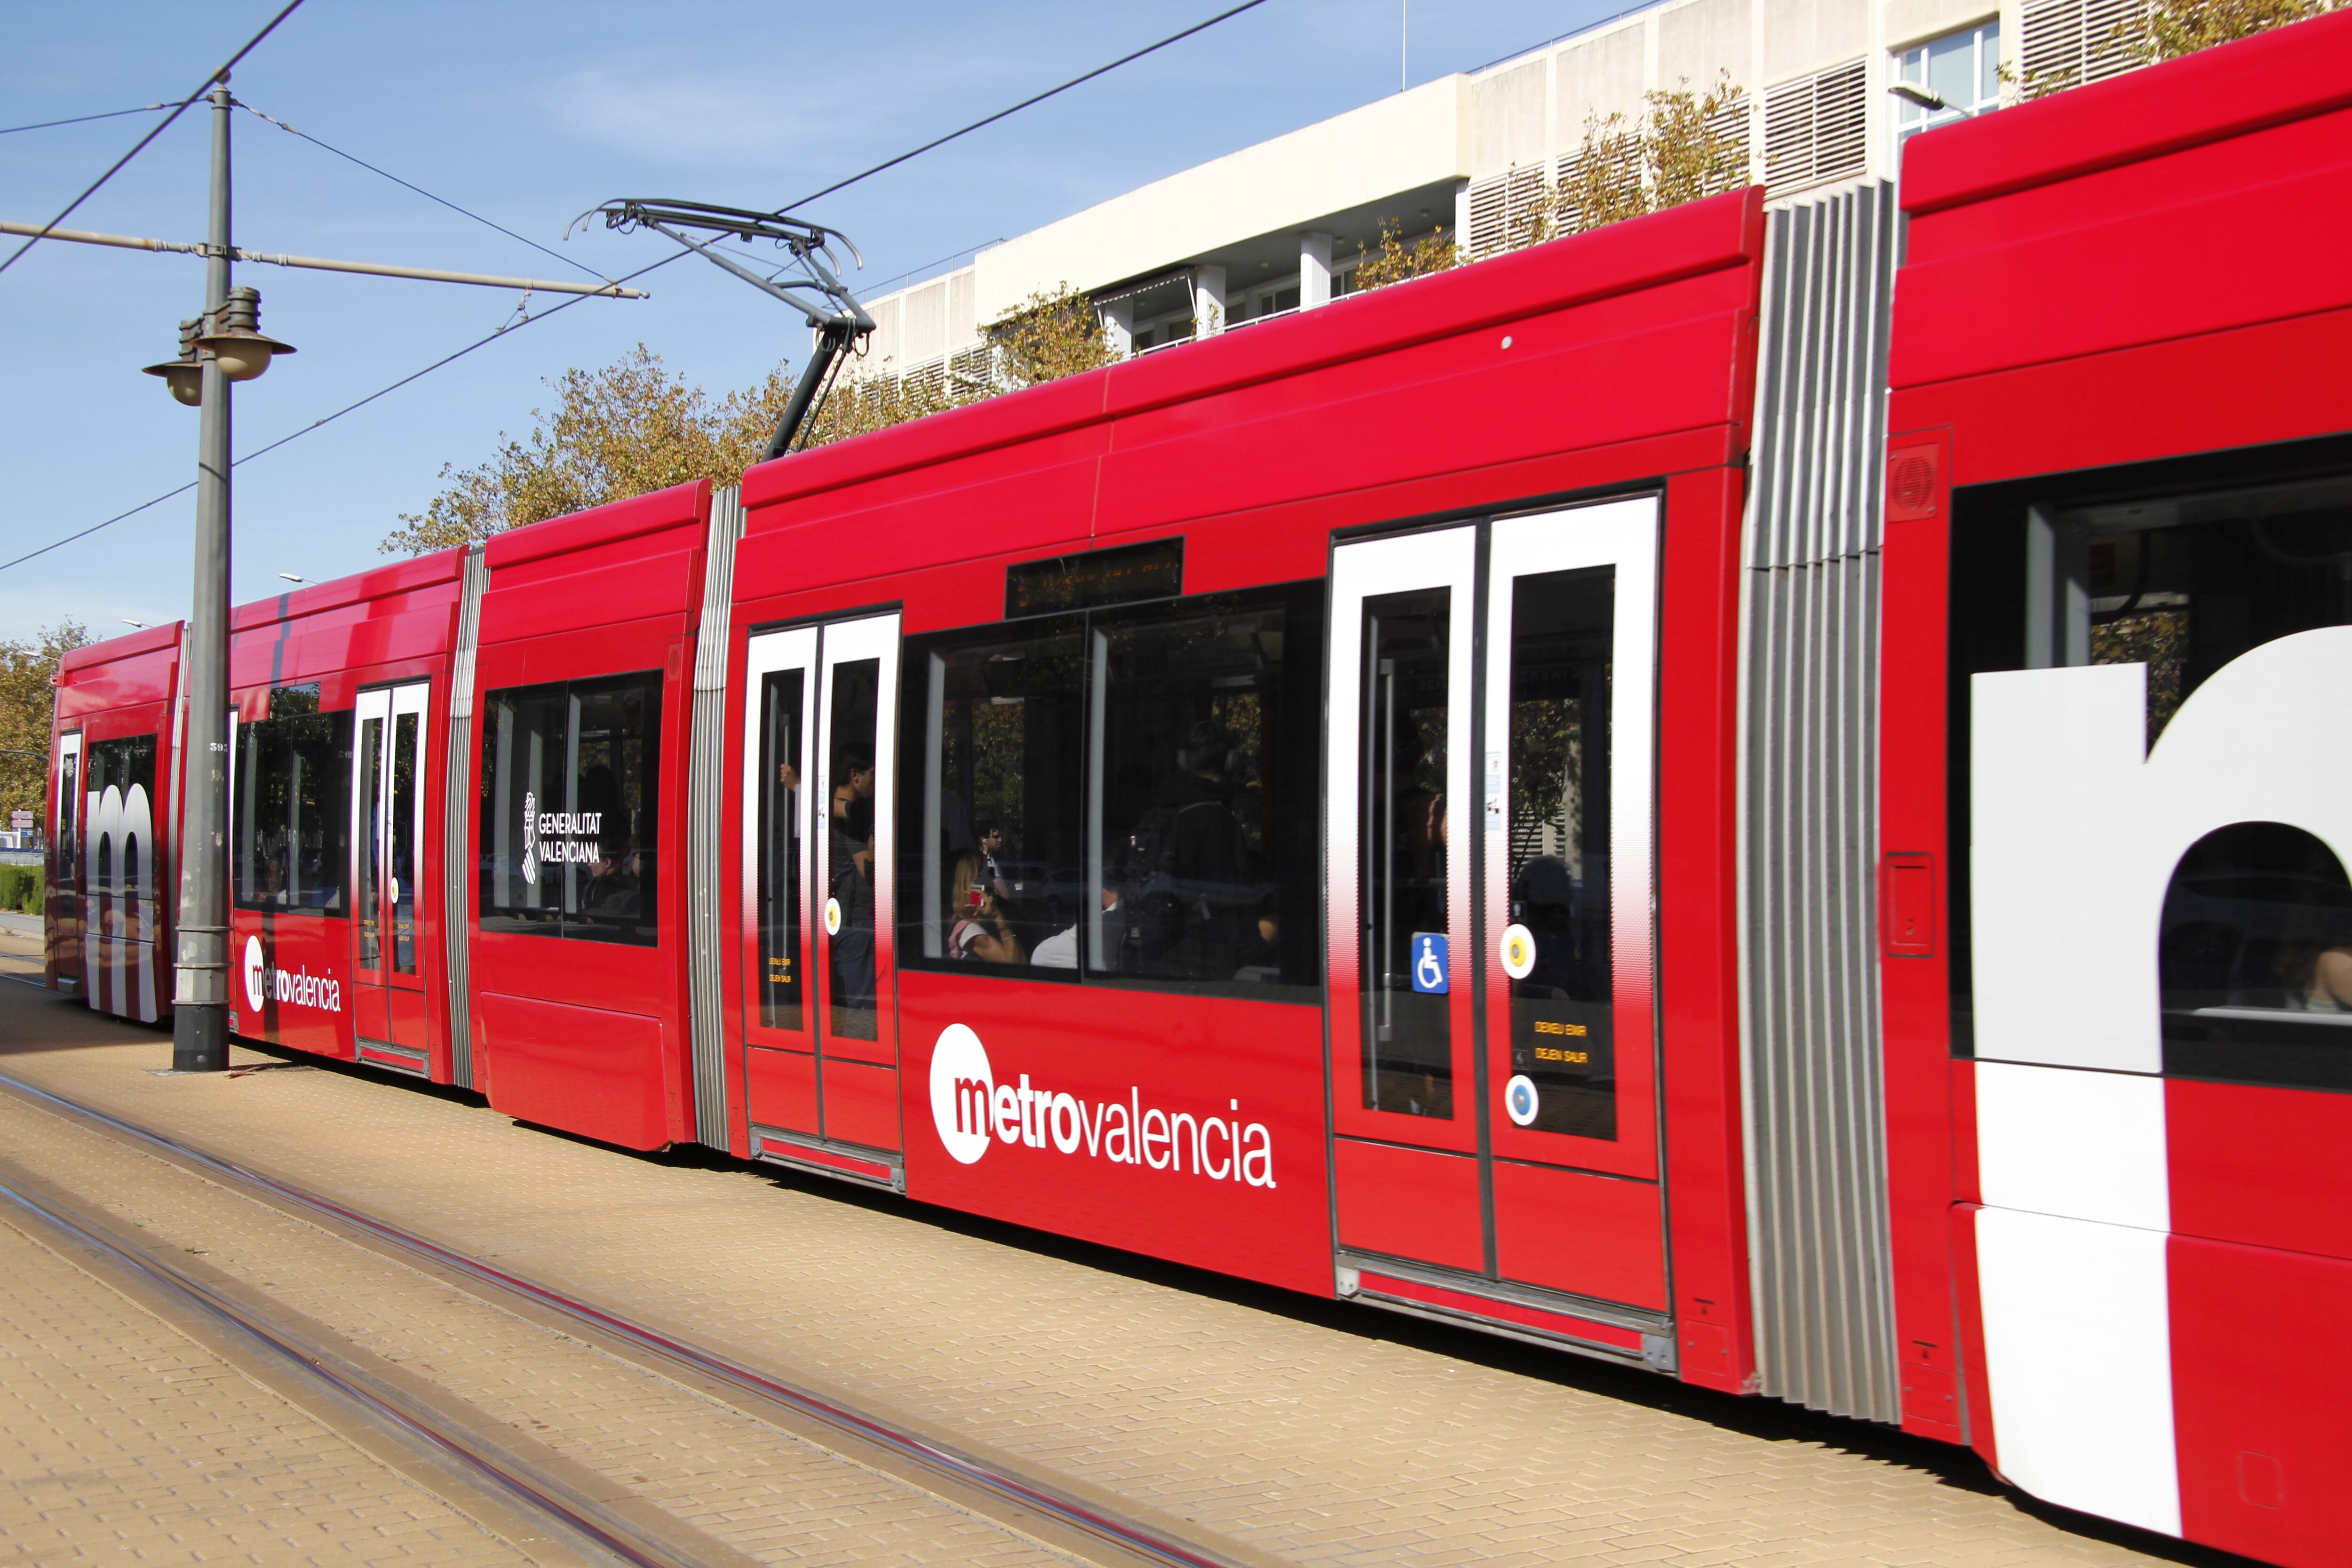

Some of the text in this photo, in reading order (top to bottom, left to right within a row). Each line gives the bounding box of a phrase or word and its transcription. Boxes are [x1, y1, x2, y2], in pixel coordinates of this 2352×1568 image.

[539, 812, 602, 834] GENERALITAT
[539, 841, 600, 863] VALENCIANA
[252, 961, 341, 1012] metrovalencia
[954, 1073, 1277, 1189] metrovalencia
